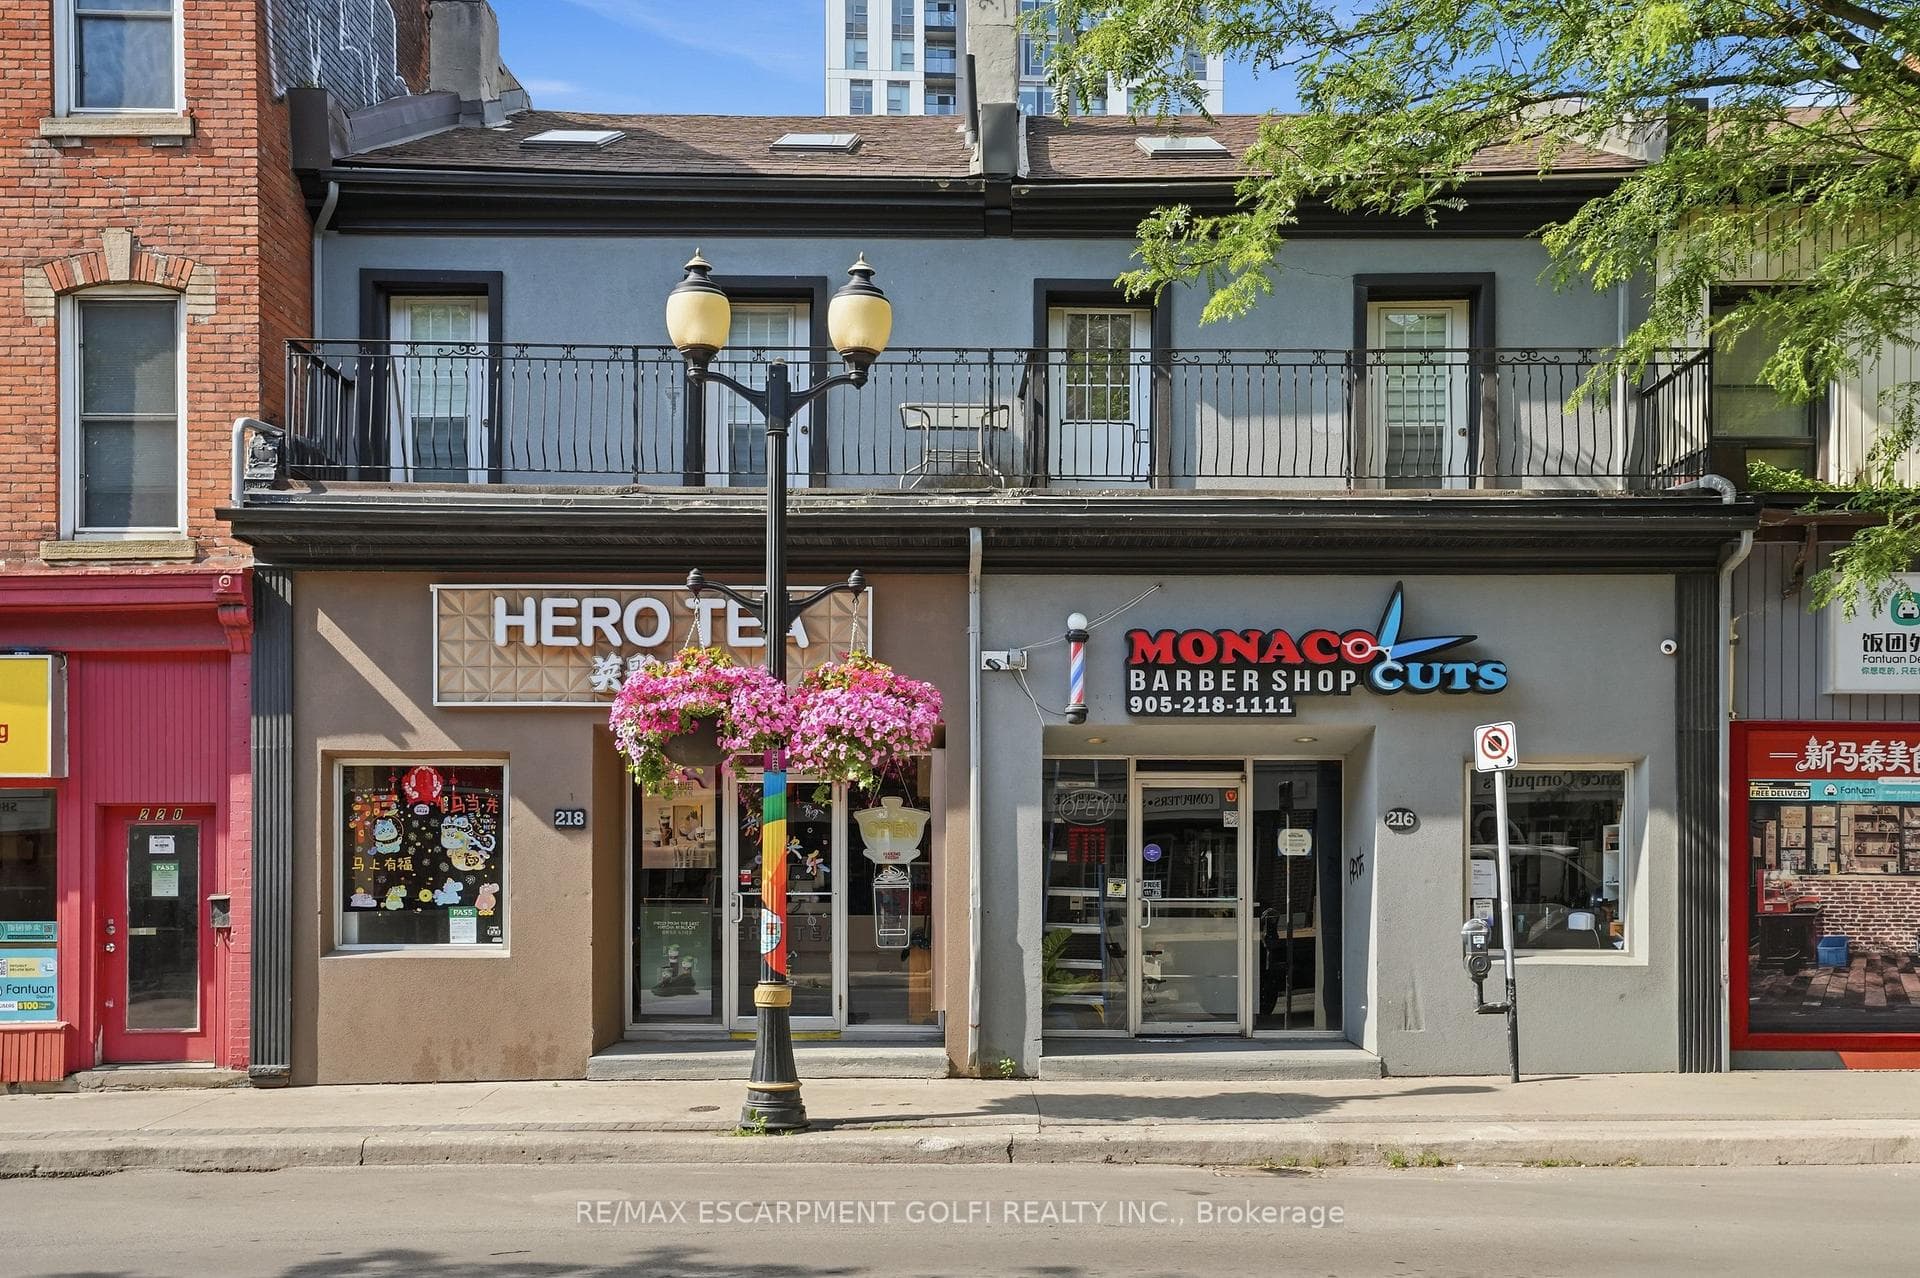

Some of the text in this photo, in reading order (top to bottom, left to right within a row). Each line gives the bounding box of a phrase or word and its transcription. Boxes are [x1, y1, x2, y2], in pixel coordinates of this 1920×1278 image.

[493, 597, 671, 647] HERO
[1128, 631, 1378, 665] MONACO
[1863, 654, 1907, 664] Fantuan
[1130, 669, 1356, 692] BARBER SHOP
[1371, 661, 1508, 690] CUTS
[1130, 696, 1293, 713] 905-218-1111
[1840, 786, 1876, 795] Fantuan
[140, 808, 183, 820] 220
[555, 811, 585, 825] 218
[1387, 811, 1415, 826] 216
[351, 855, 415, 872] 马上有福
[6, 983, 55, 994] Fantuan
